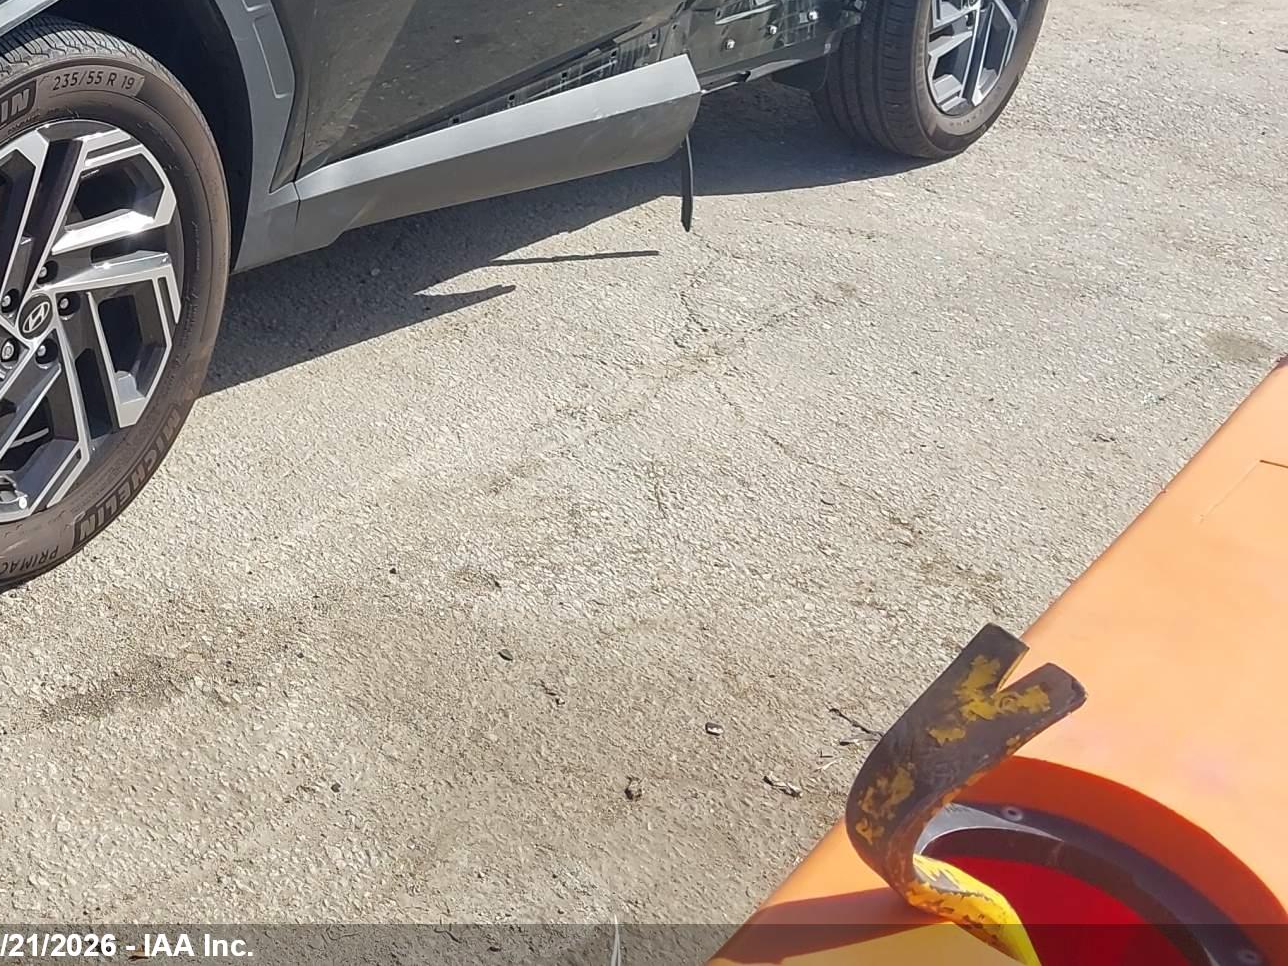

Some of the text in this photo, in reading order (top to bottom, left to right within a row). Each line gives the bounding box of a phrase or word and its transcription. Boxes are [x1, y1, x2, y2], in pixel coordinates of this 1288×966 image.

[52, 70, 135, 91] 235/55 R 19
[78, 408, 182, 541] MICHELIN
